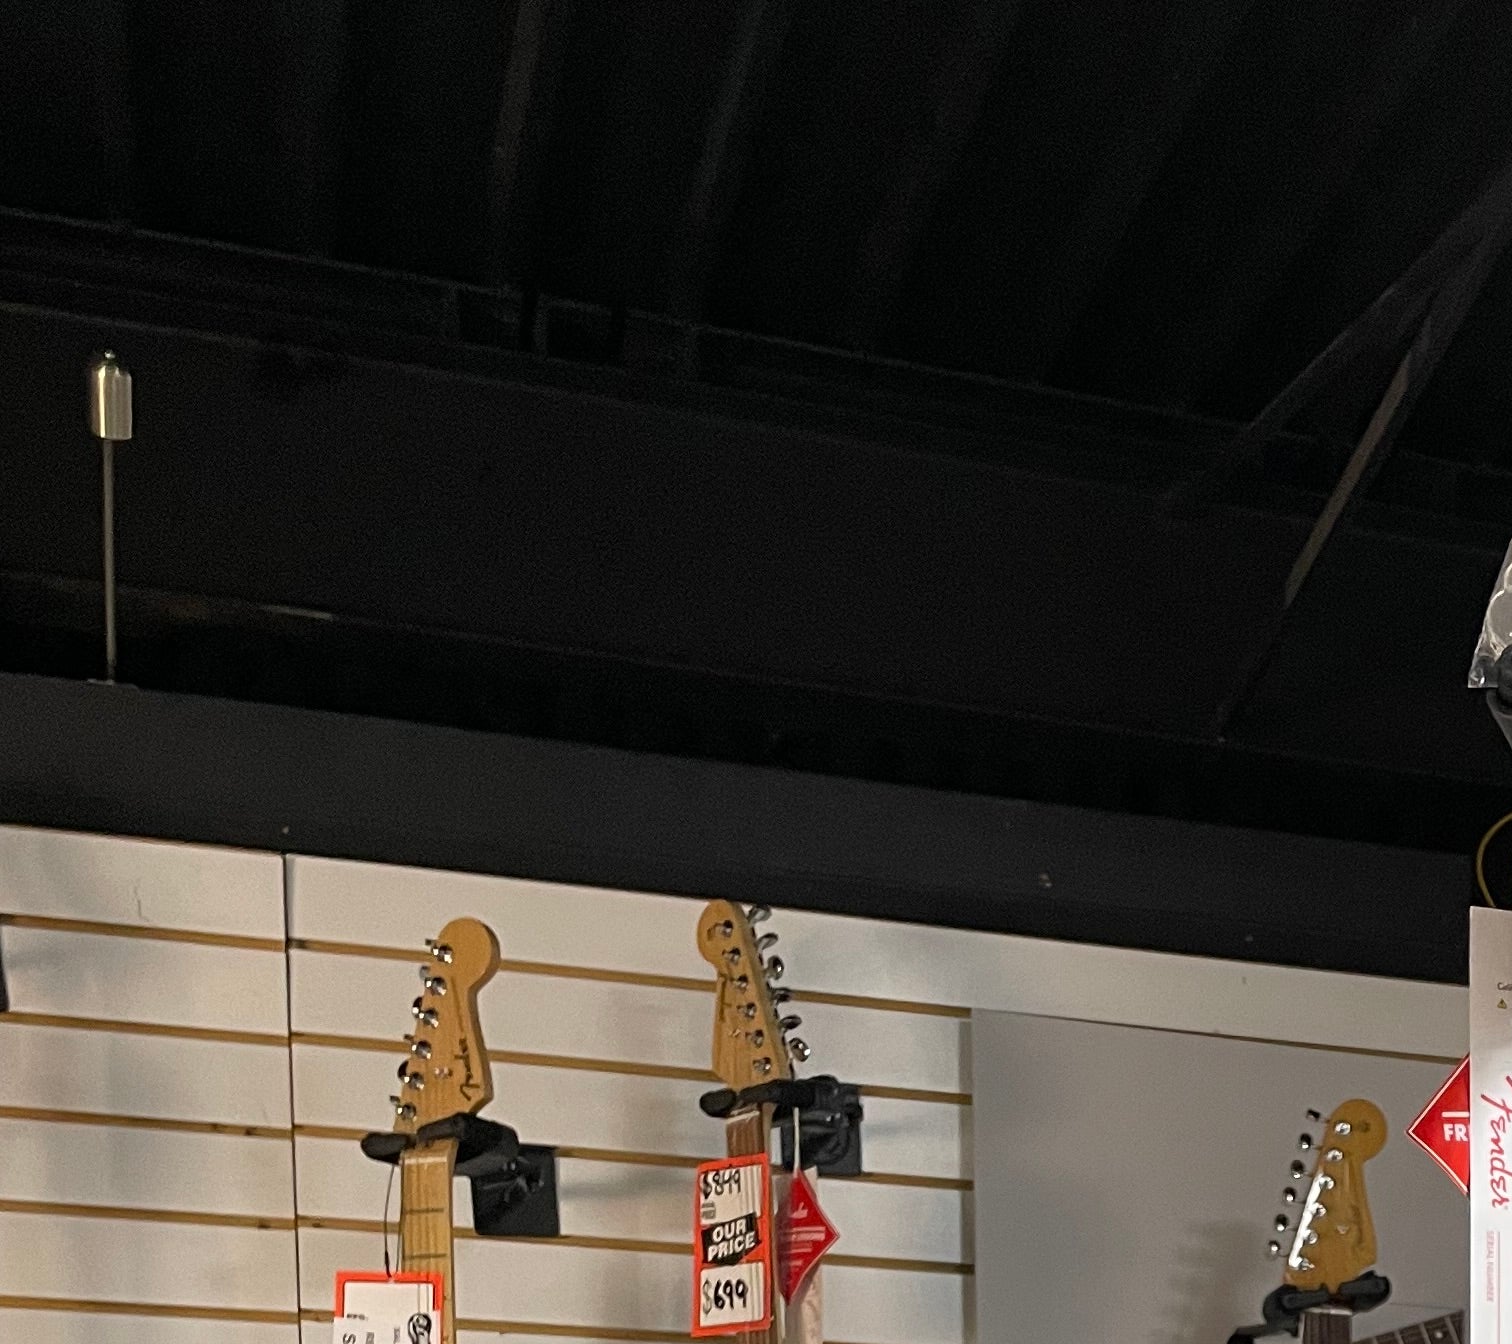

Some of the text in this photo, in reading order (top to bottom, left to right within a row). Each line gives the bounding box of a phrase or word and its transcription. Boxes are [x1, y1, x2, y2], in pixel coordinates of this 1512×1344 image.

[1443, 1122, 1470, 1142] FR
[712, 1217, 747, 1243] OUR
[707, 1231, 756, 1263] PRICE
[702, 1276, 749, 1315] $699
